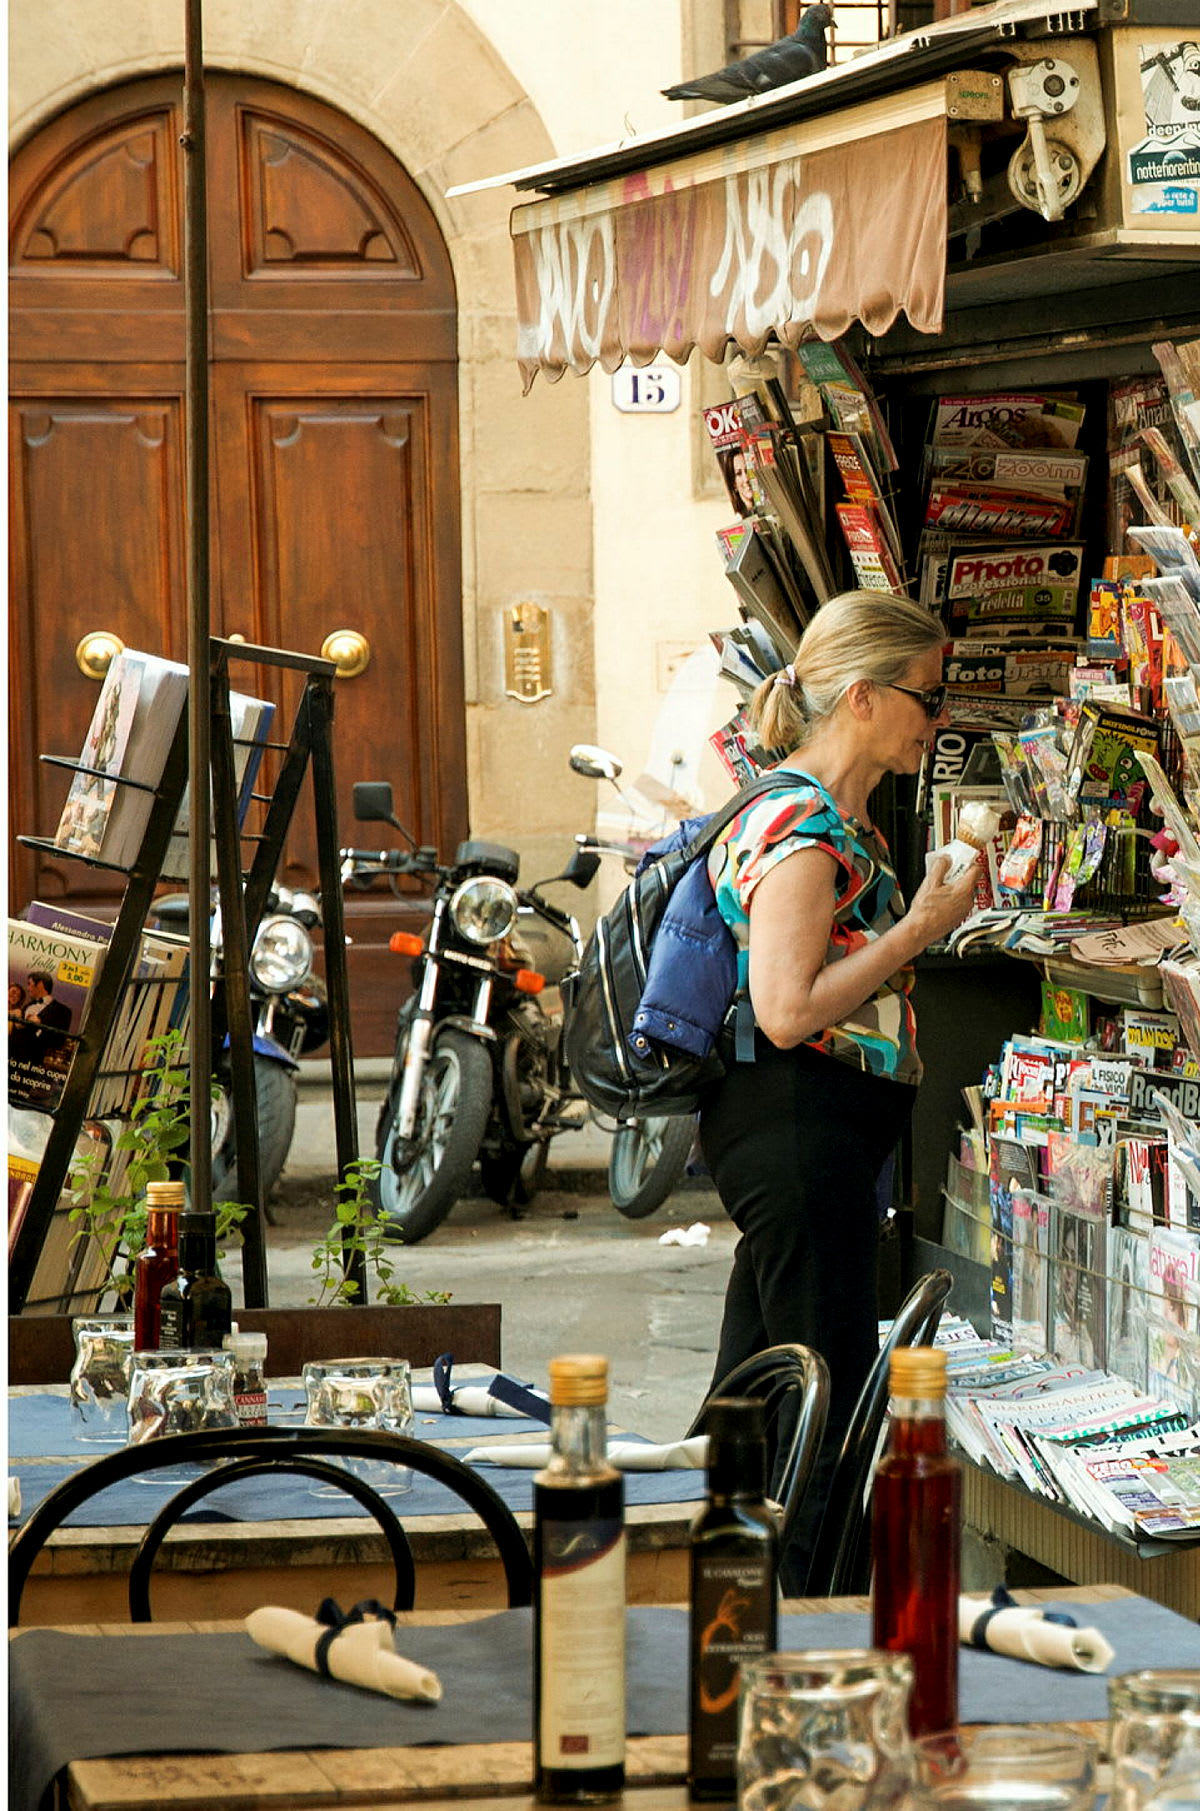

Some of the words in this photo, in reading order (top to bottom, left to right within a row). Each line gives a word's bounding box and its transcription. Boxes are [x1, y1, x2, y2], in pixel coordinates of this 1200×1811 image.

[630, 374, 665, 404] 15
[943, 406, 1027, 430] Argos
[955, 556, 1044, 584] Photo
[52, 921, 97, 941] Alessandro
[18, 1060, 30, 1072] nel
[32, 1064, 46, 1076] mio
[46, 1070, 67, 1081] cuore
[1099, 1069, 1125, 1084] FISICO
[10, 1074, 21, 1085] da
[22, 1076, 51, 1092] scoprire
